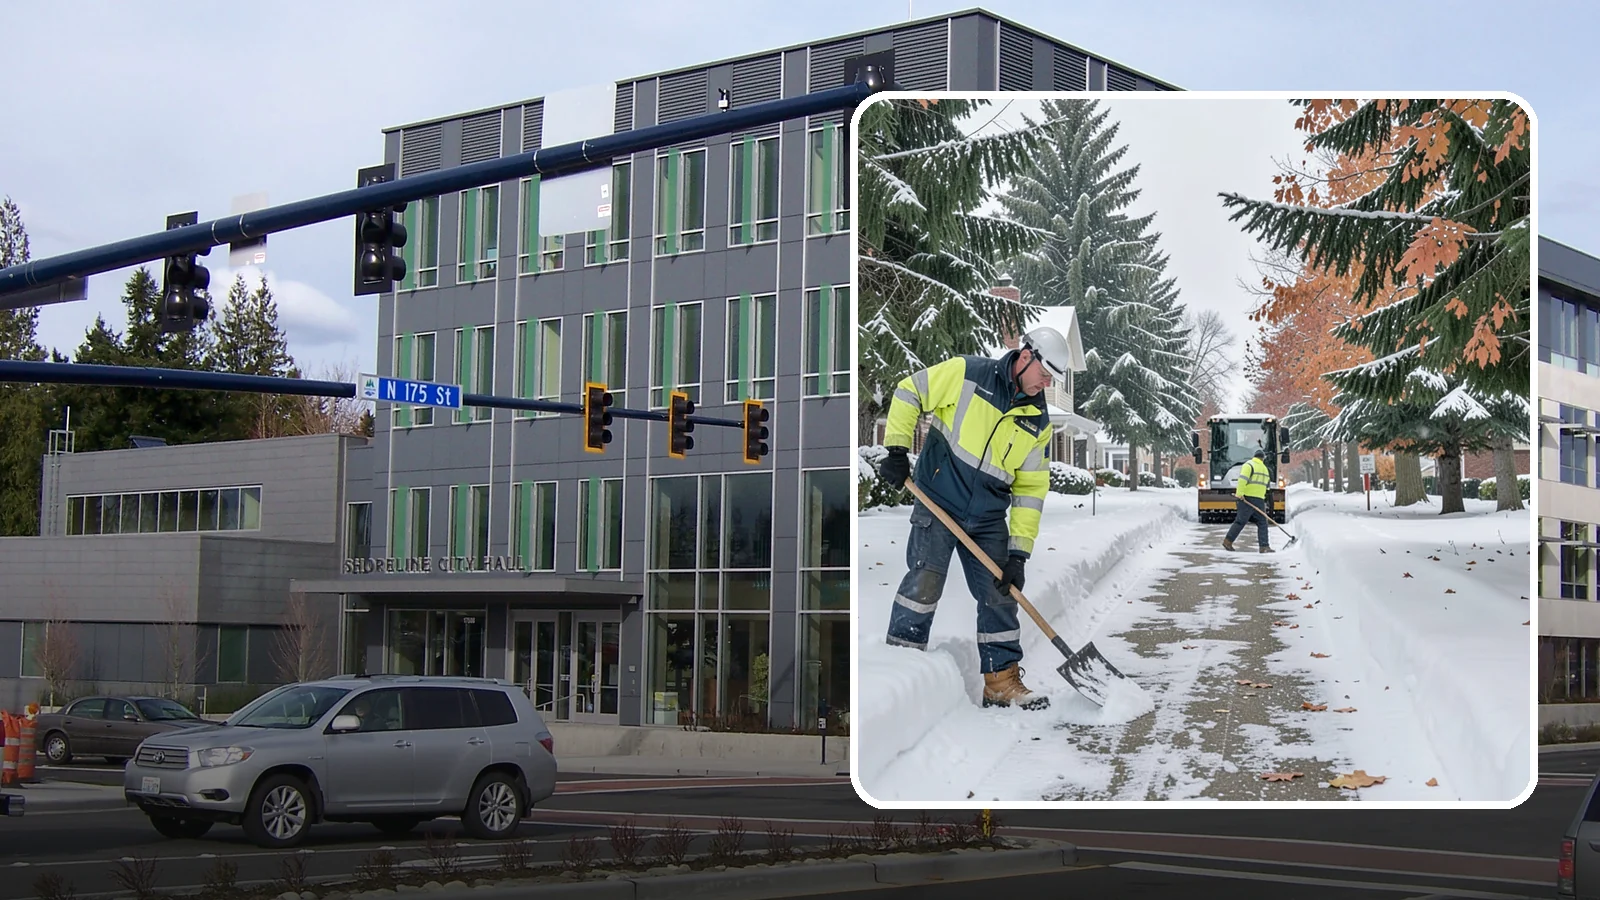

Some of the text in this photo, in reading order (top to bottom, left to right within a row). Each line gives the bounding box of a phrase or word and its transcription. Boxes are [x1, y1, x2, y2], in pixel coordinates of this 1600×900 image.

[387, 380, 451, 406] N 175 St
[344, 555, 526, 574] SHORELINE CITY HALL
